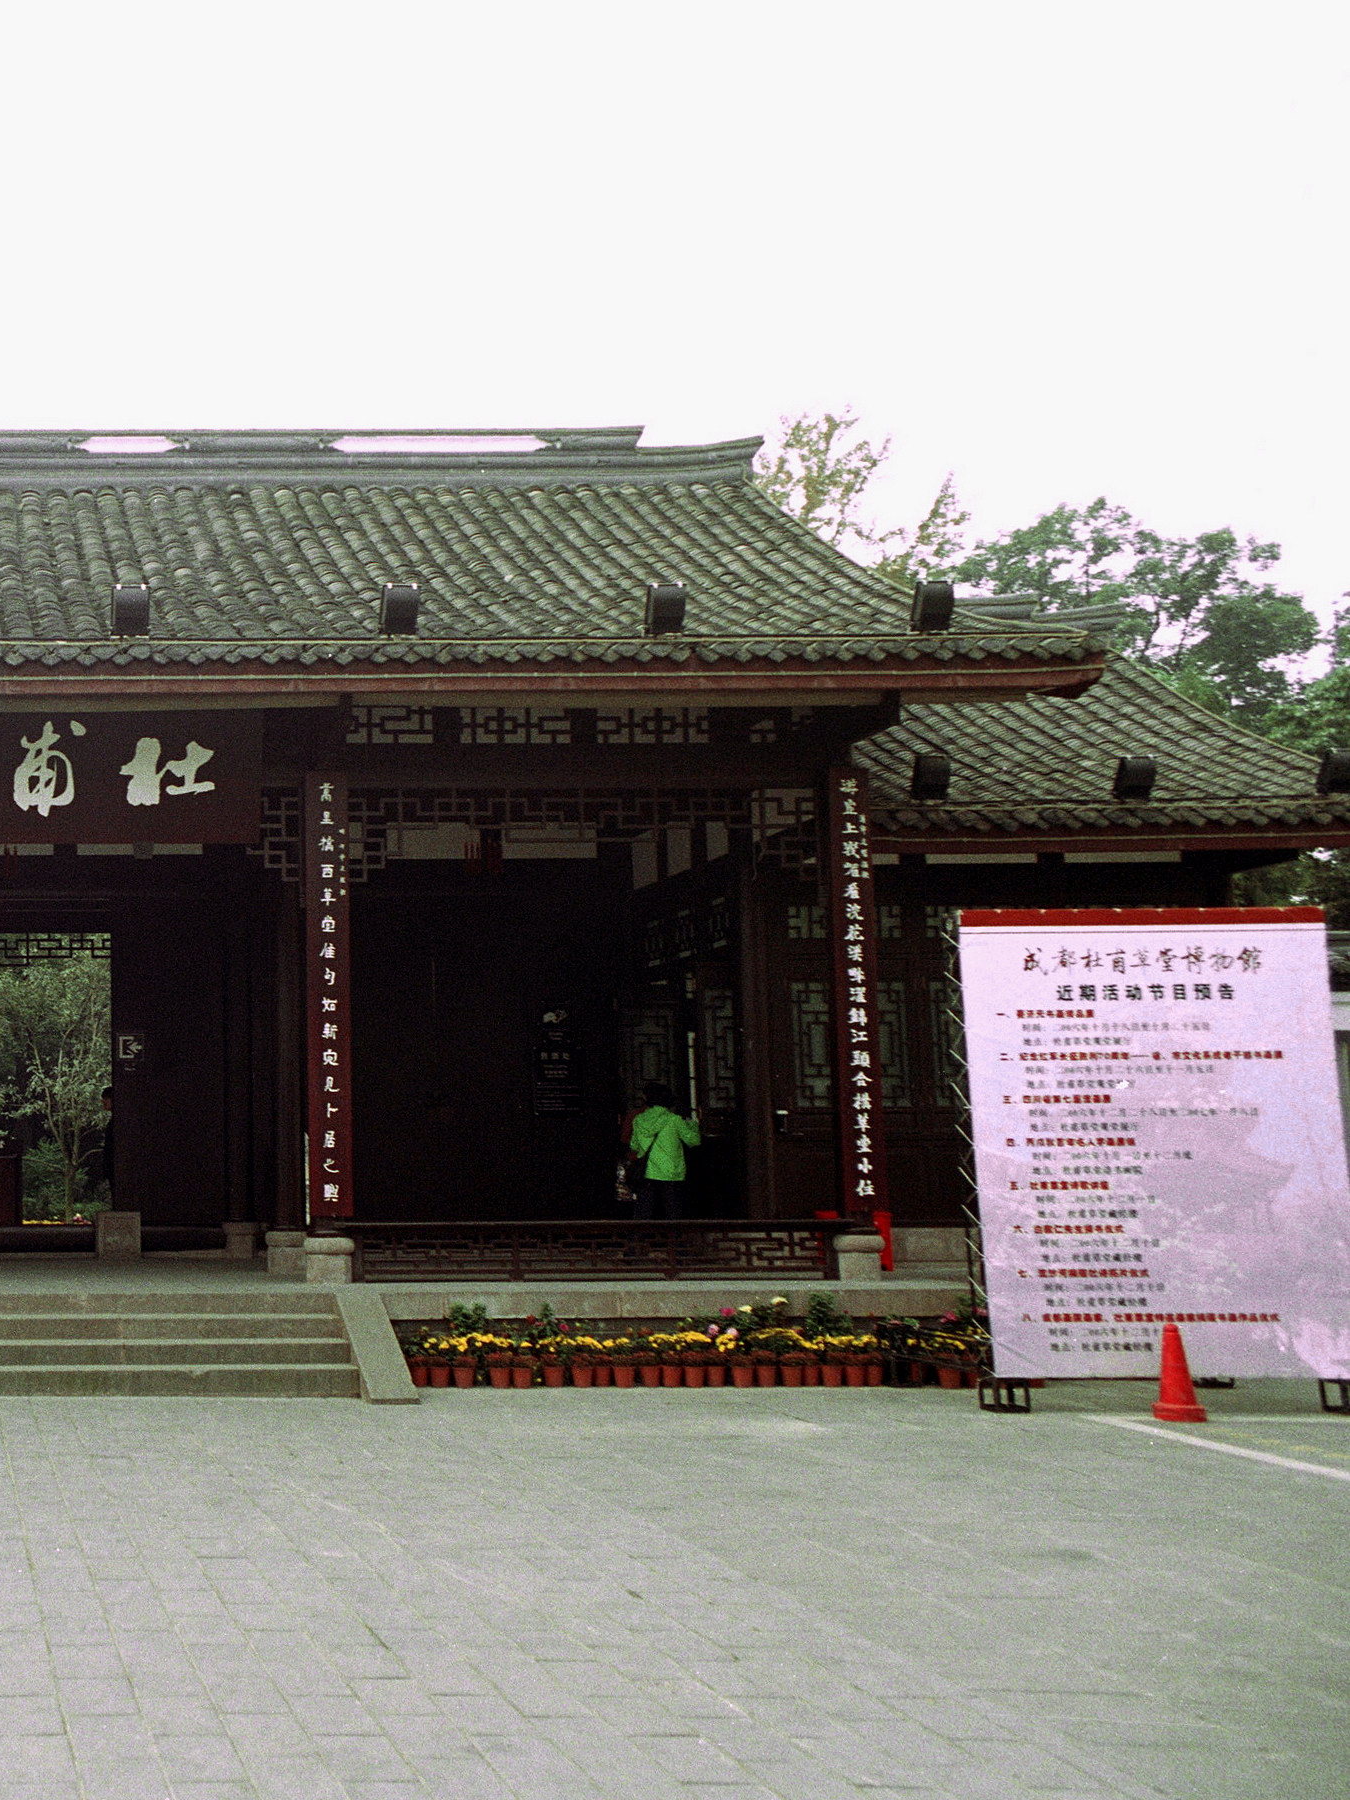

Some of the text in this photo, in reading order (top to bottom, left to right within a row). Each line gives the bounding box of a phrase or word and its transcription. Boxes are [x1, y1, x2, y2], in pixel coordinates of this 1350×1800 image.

[1056, 983, 1236, 1002] 近期活动节目预告
